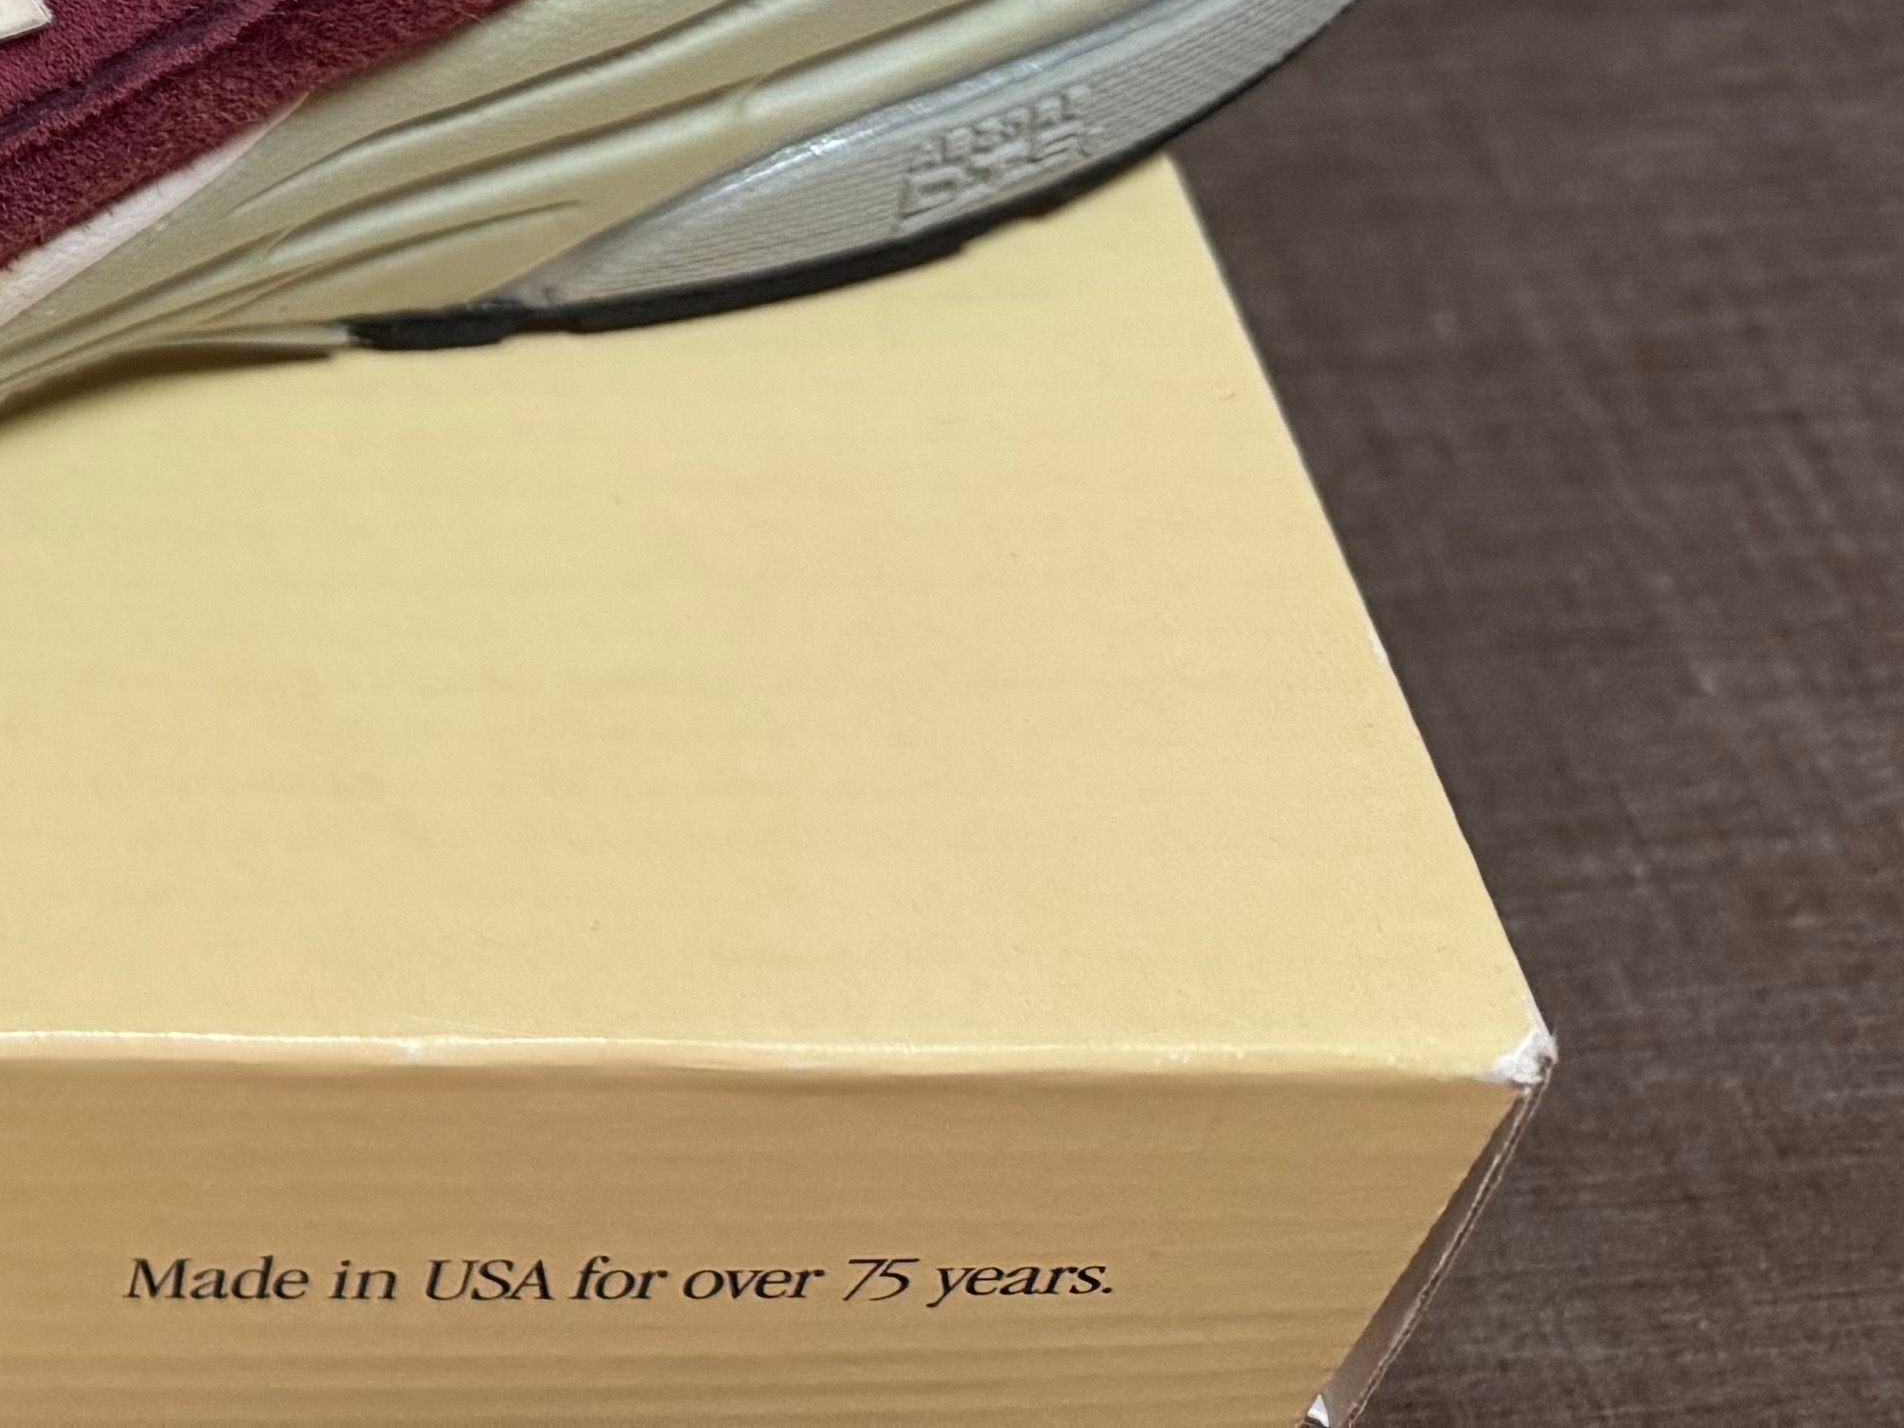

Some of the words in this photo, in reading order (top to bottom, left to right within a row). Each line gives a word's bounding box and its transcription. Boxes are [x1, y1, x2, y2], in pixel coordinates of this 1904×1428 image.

[123, 1254, 309, 1301] Made
[328, 1257, 396, 1301] in
[425, 1258, 553, 1302] USA
[568, 1254, 668, 1302] for
[682, 1266, 825, 1301] over
[842, 1257, 920, 1303] 75
[927, 1256, 1115, 1310] years.
